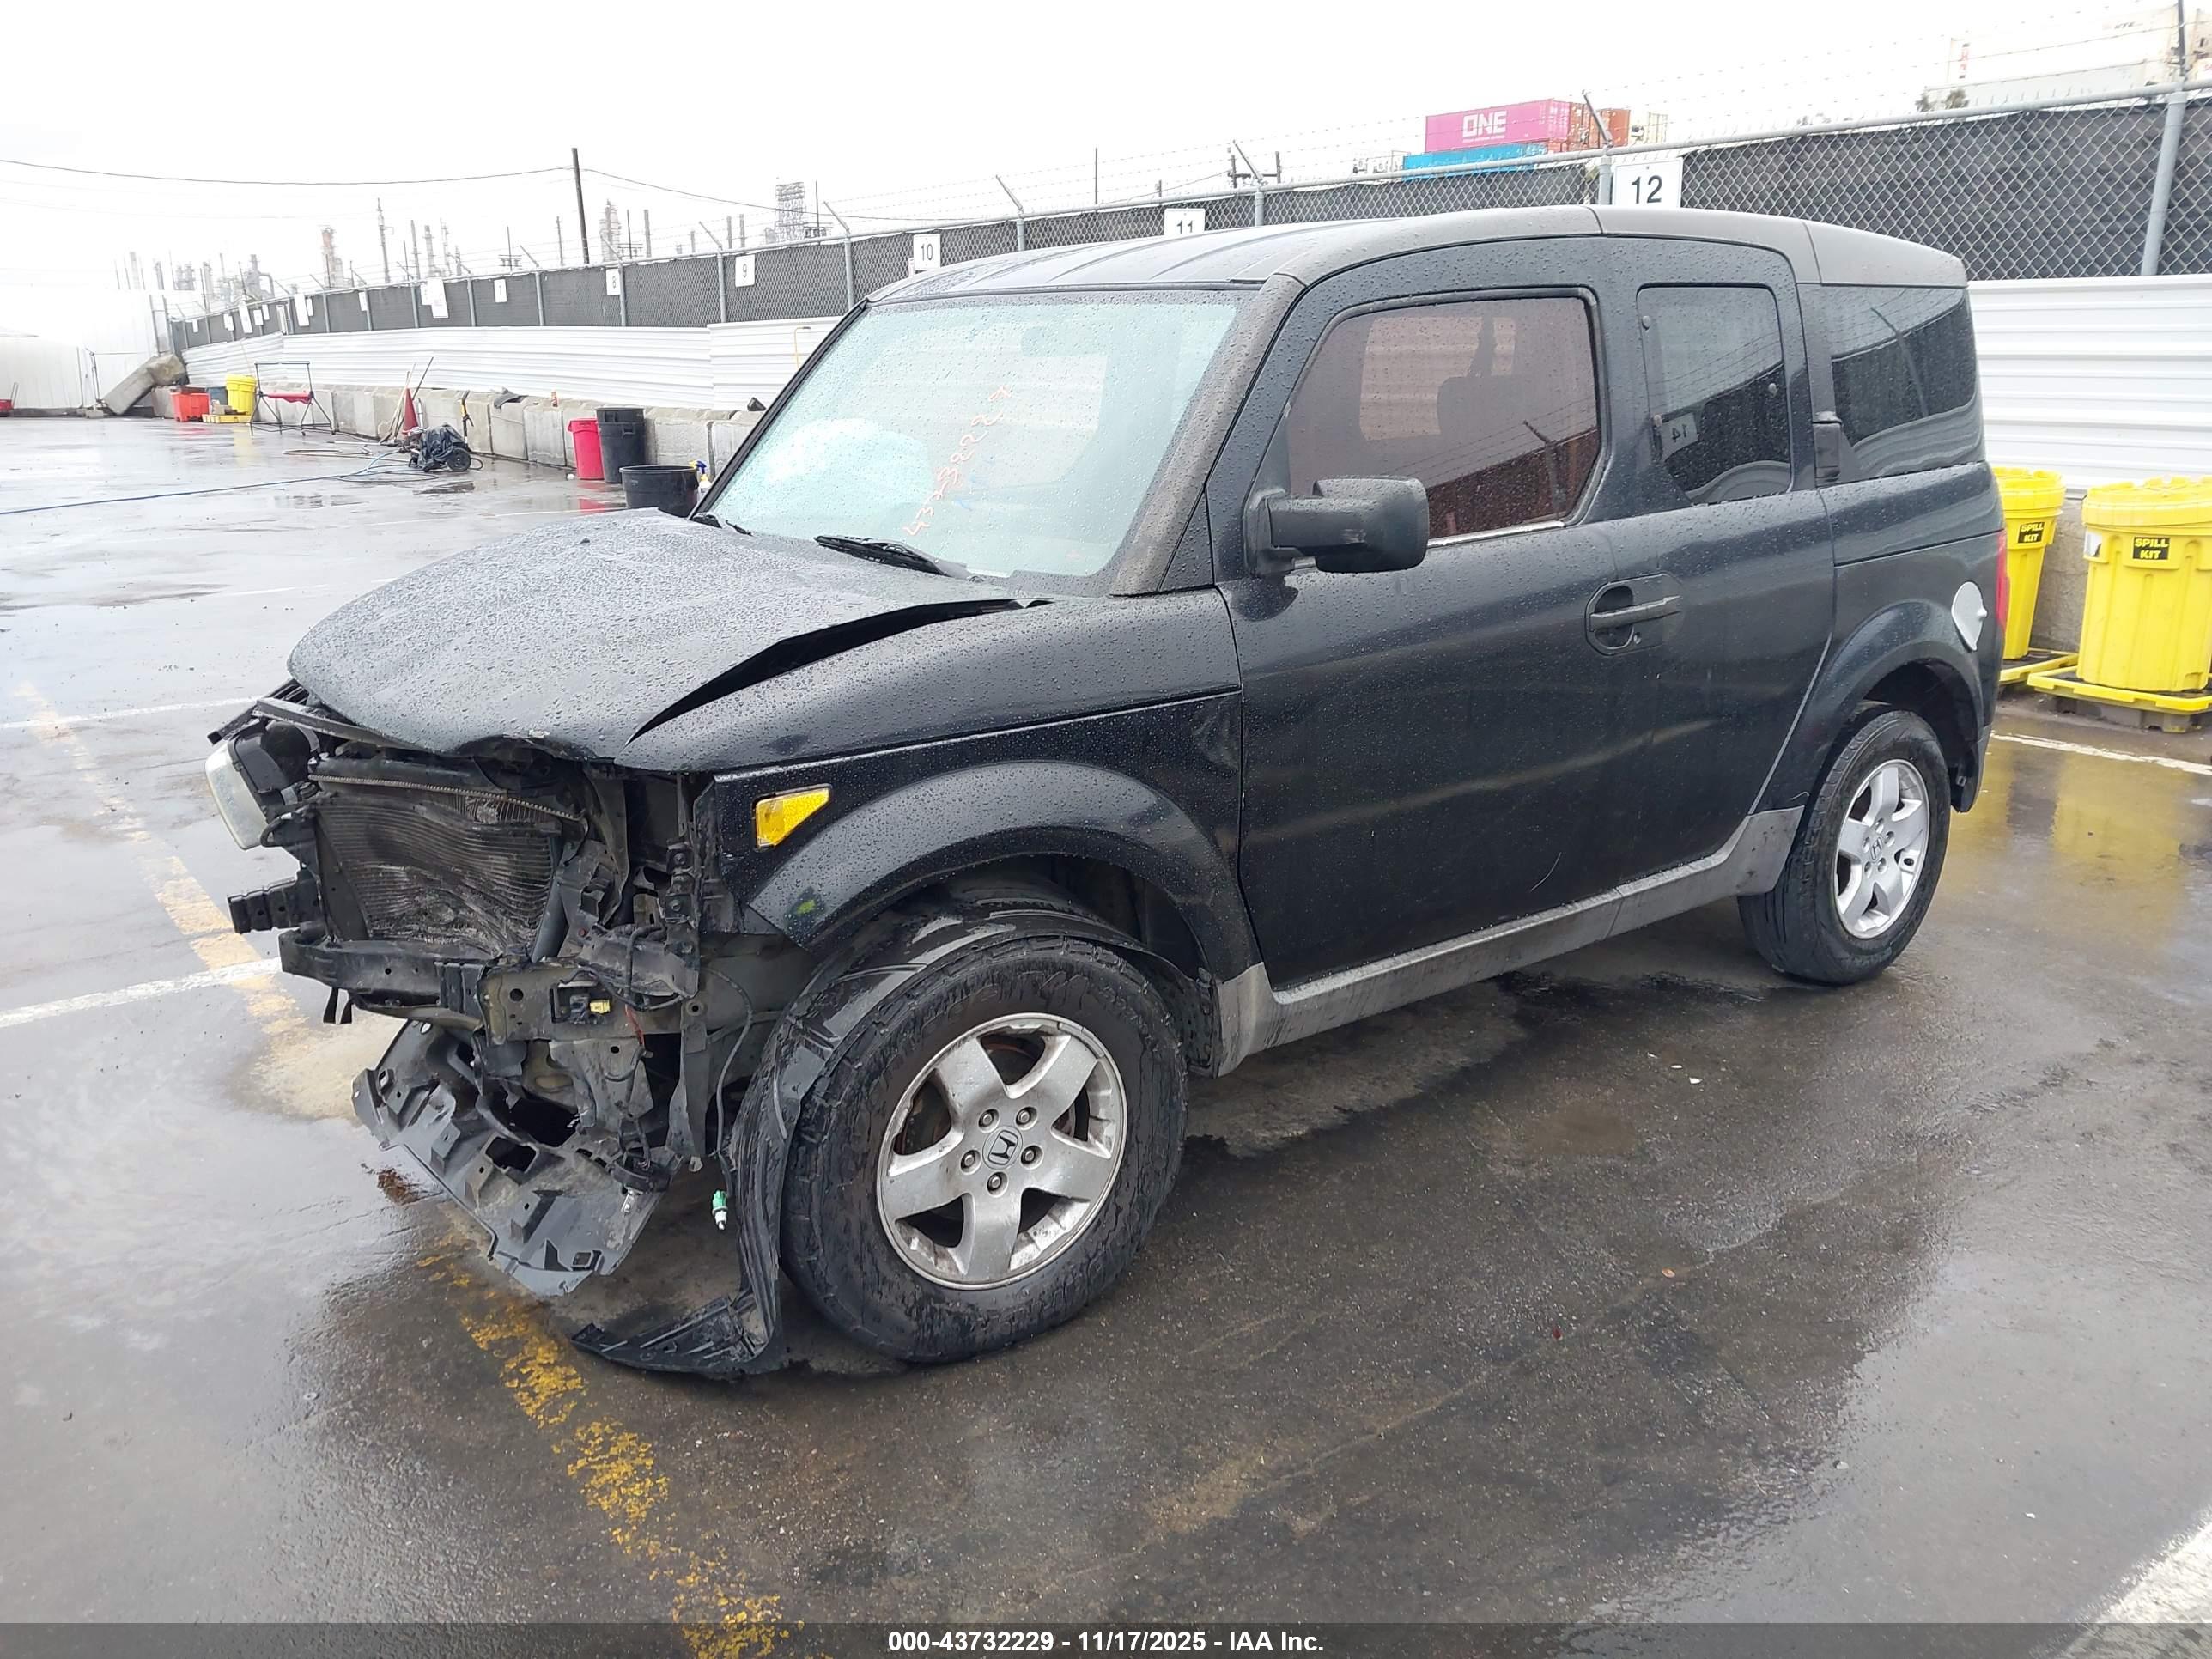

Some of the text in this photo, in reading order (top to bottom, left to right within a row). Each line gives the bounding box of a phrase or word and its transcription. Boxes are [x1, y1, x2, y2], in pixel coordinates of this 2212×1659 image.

[1462, 111, 1507, 137] ONE
[1632, 175, 1662, 204] 12
[1176, 220, 1193, 234] 11
[921, 243, 933, 261] 10
[742, 263, 748, 279] 9
[2021, 522, 2044, 532] SPILL
[2023, 533, 2039, 543] KIT
[2134, 538, 2169, 548] SPILL
[2140, 550, 2161, 560] KIT
